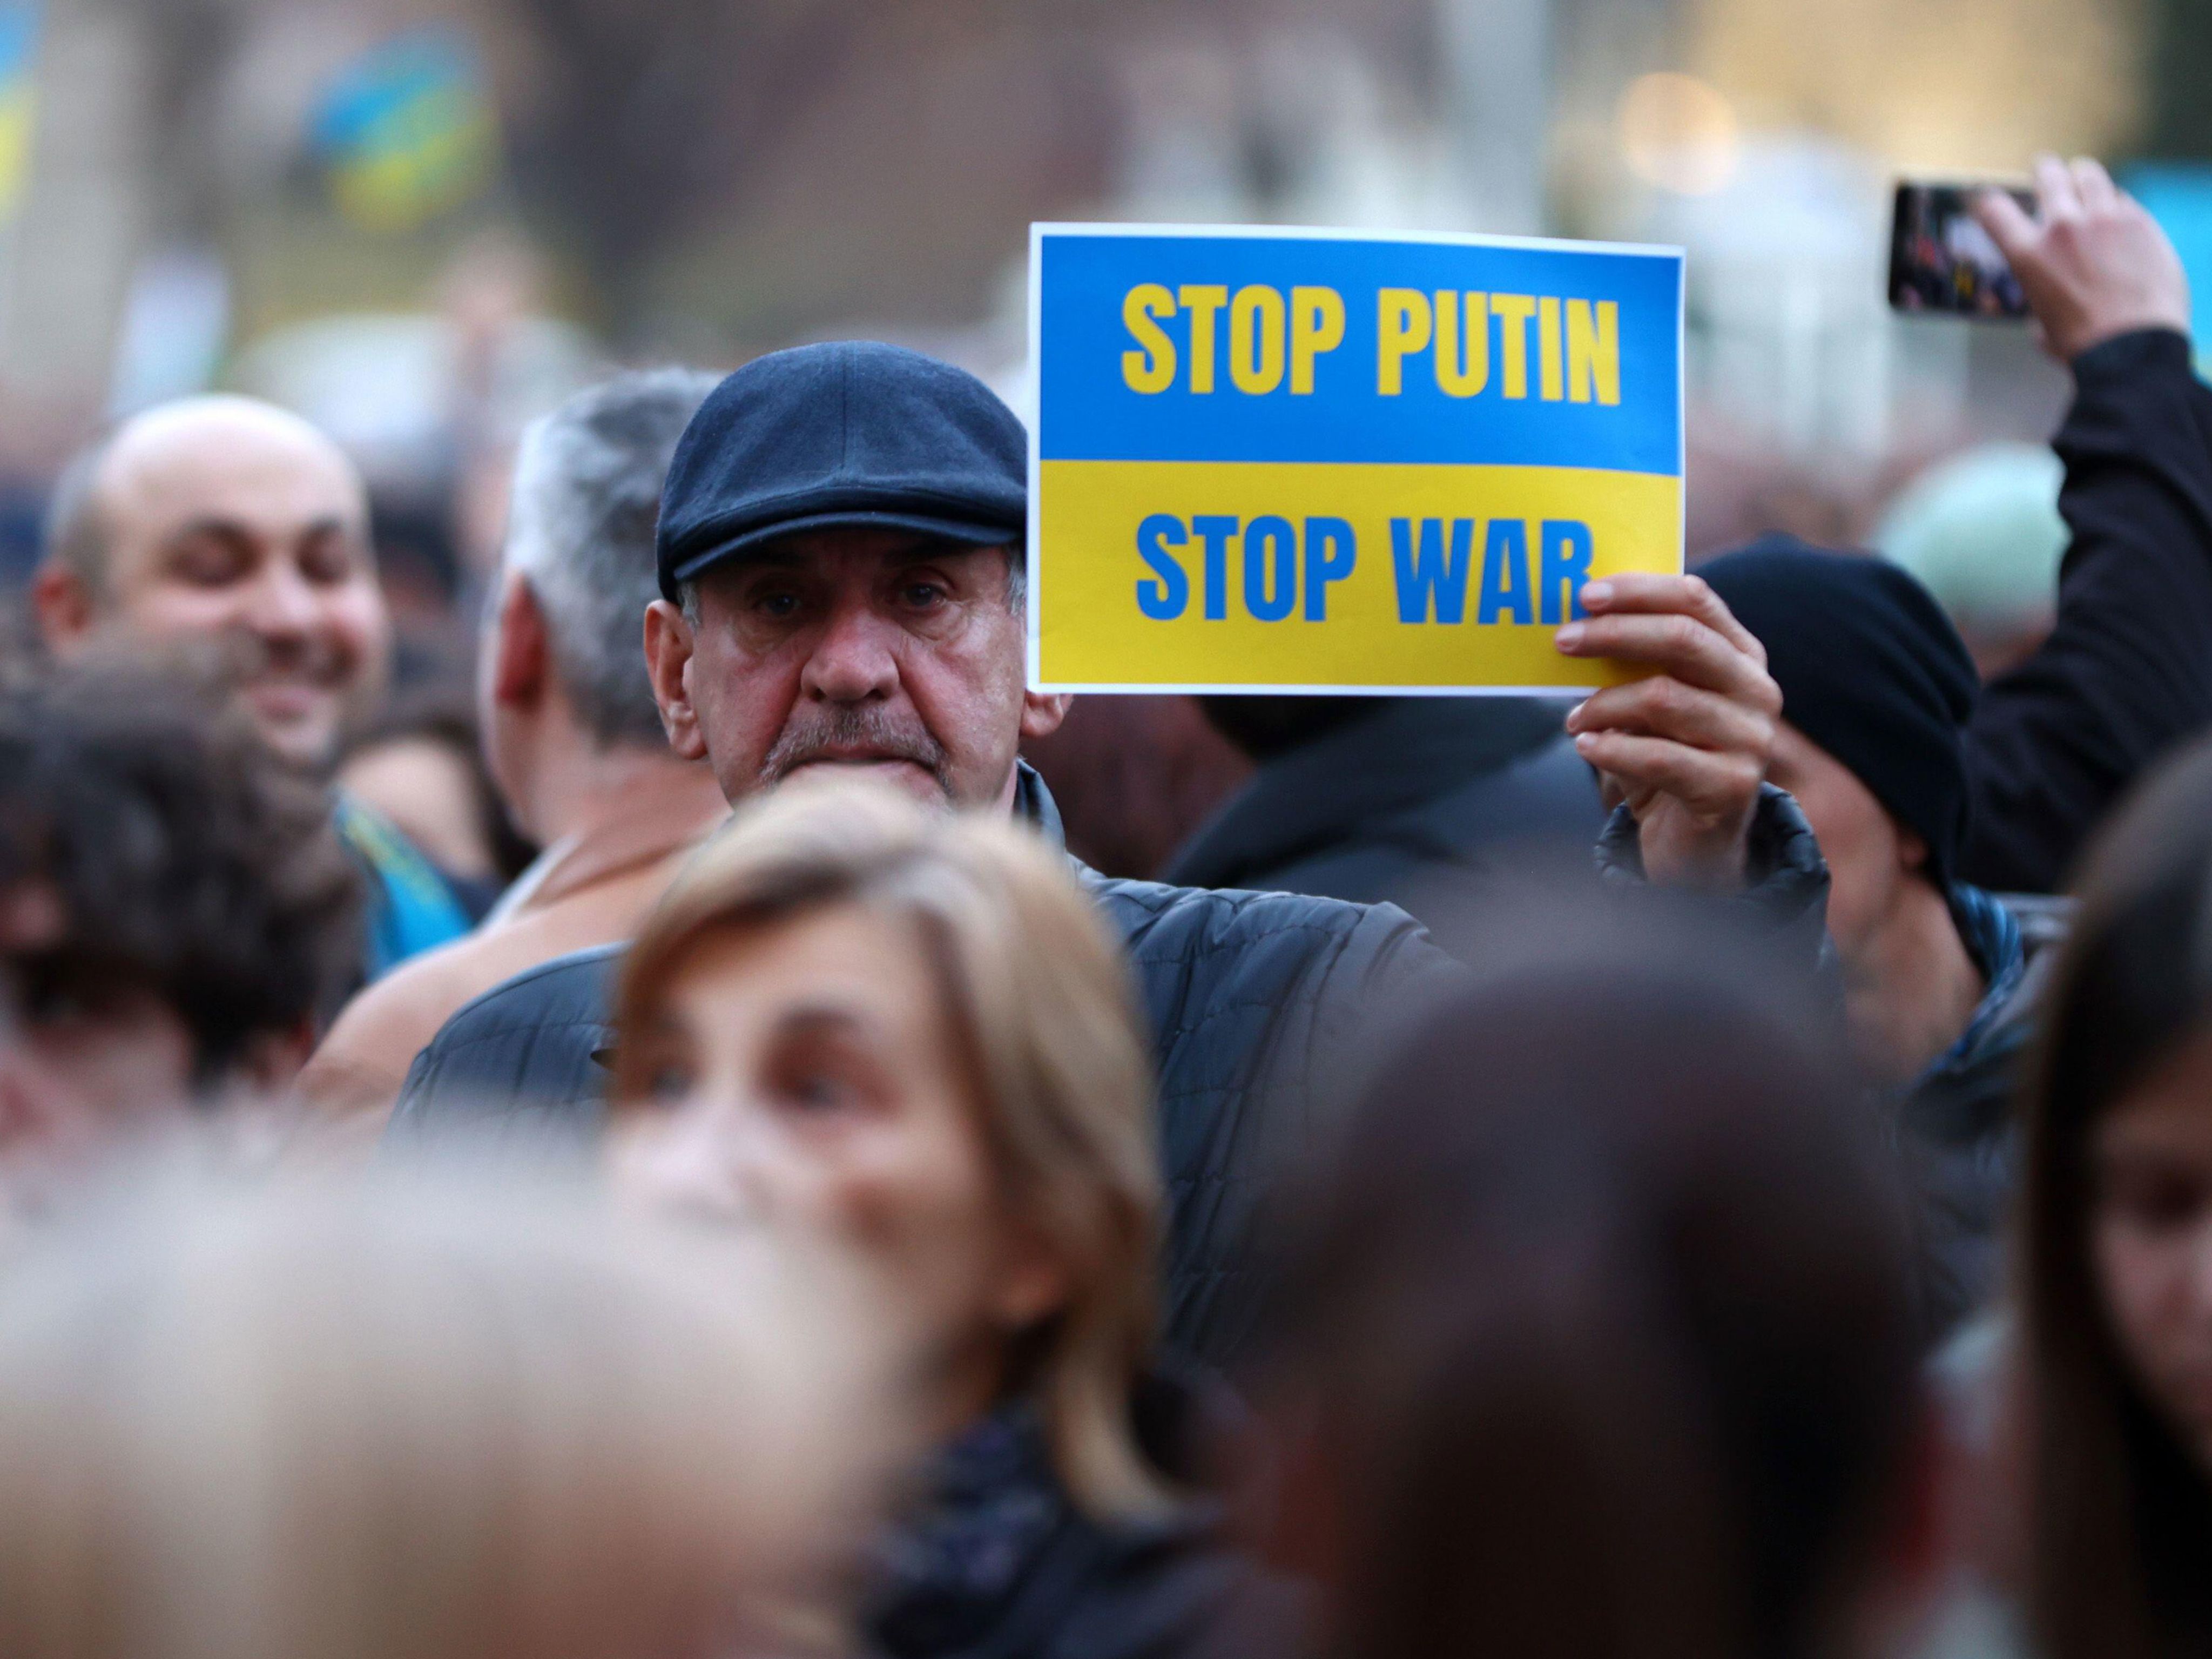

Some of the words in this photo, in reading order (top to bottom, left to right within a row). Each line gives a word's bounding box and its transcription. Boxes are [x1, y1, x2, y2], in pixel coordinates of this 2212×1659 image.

[1122, 283, 1345, 395] STOP
[1378, 288, 1620, 405] PUTIN
[1136, 513, 1357, 623] STOP
[1389, 517, 1594, 625] WAR
